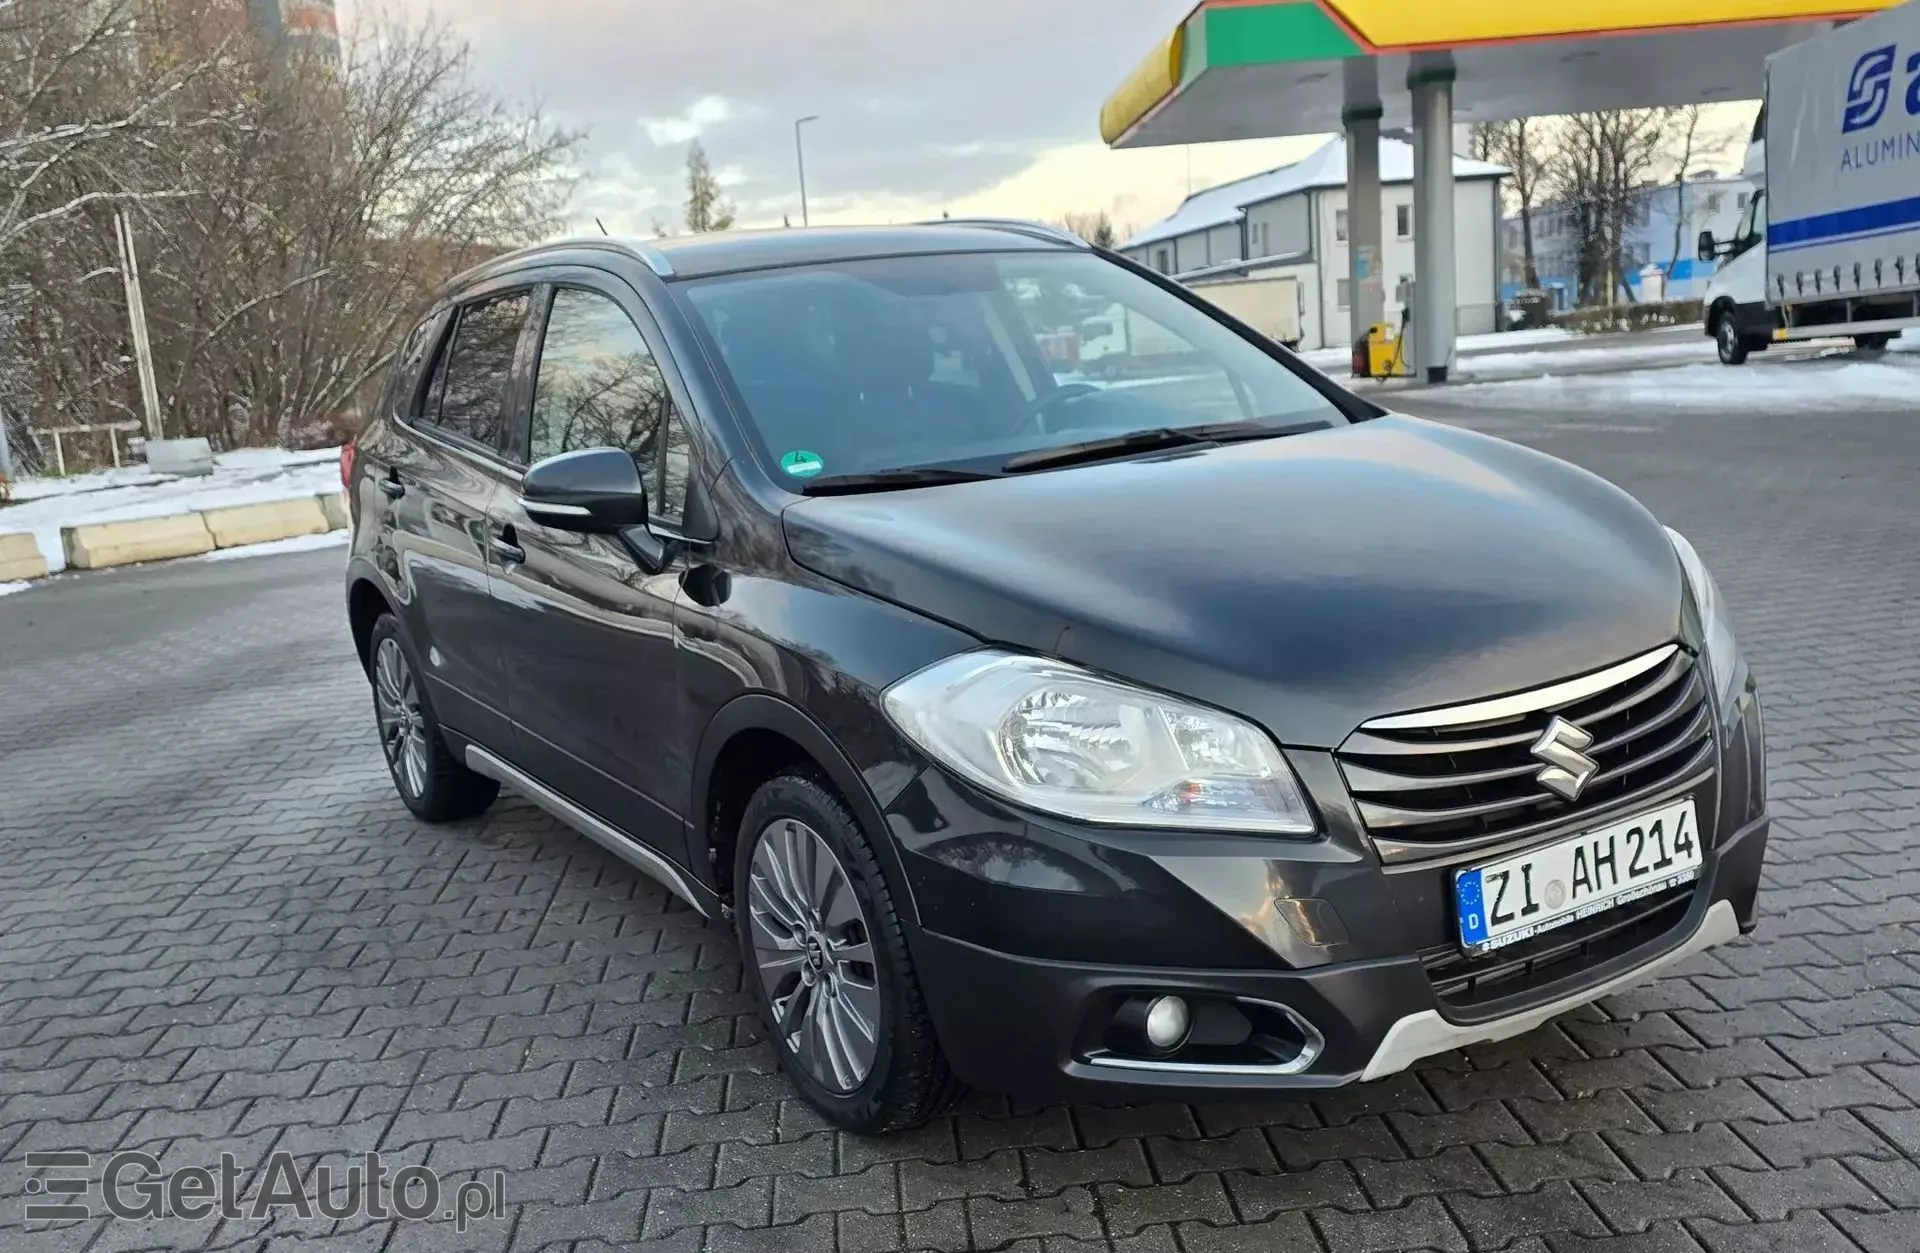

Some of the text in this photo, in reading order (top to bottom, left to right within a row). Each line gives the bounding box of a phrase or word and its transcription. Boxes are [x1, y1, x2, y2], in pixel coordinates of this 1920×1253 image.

[1841, 130, 1920, 172] ALUMIN
[1485, 863, 1541, 927] ZI
[1468, 913, 1479, 930] D
